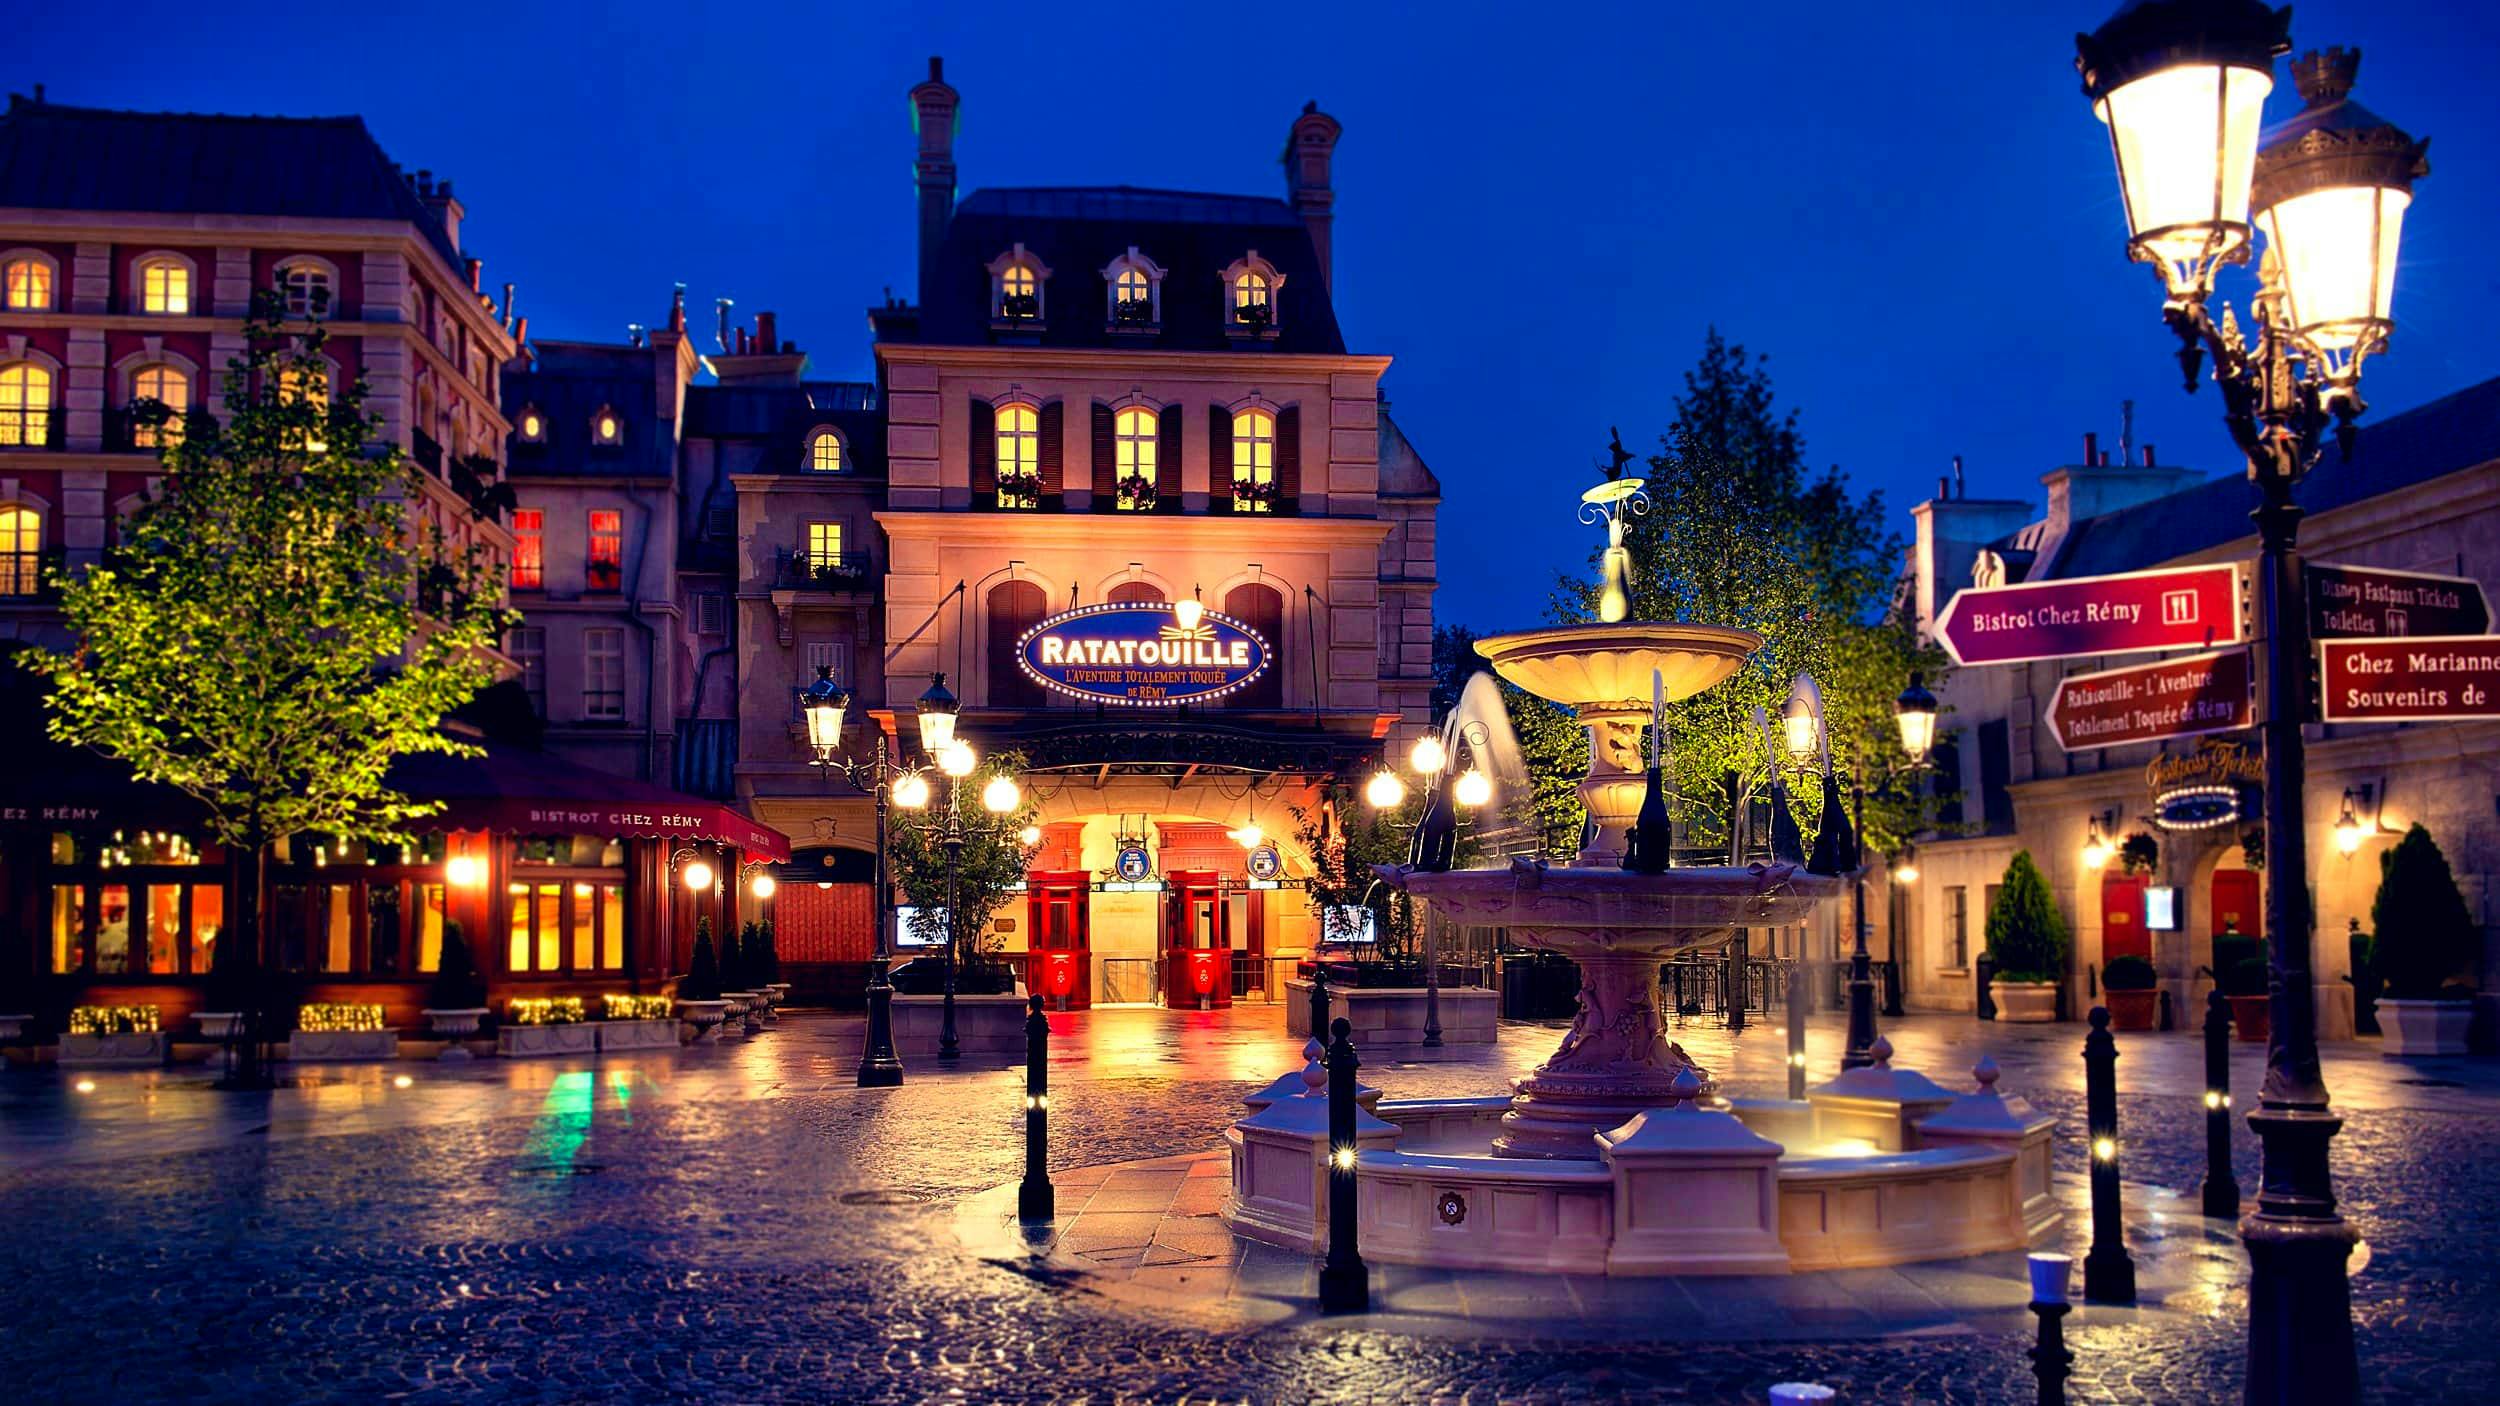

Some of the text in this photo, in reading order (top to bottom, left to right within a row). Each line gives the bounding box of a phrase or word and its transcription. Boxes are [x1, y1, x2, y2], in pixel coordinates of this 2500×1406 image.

[2322, 580, 2360, 605] Disney
[2416, 587, 2460, 609] Tickets
[2037, 605, 2080, 627] Chez
[2086, 601, 2143, 624] Rémy
[2322, 610, 2376, 633] Toilettes
[1042, 634, 1250, 666] RATATOUILLE
[2345, 652, 2500, 674] Chez Marianne
[1065, 667, 1227, 684] L'AVENTURE TOTALEMENT TOQUÉE
[1127, 683, 1167, 699] DE RÉMY
[2347, 684, 2486, 708] Souvenirs de
[2067, 700, 2235, 738] Totalement Toquée de Rémy
[43, 804, 100, 820] RÉMY
[530, 810, 702, 828] BISTROT CHEZ RÉMY
